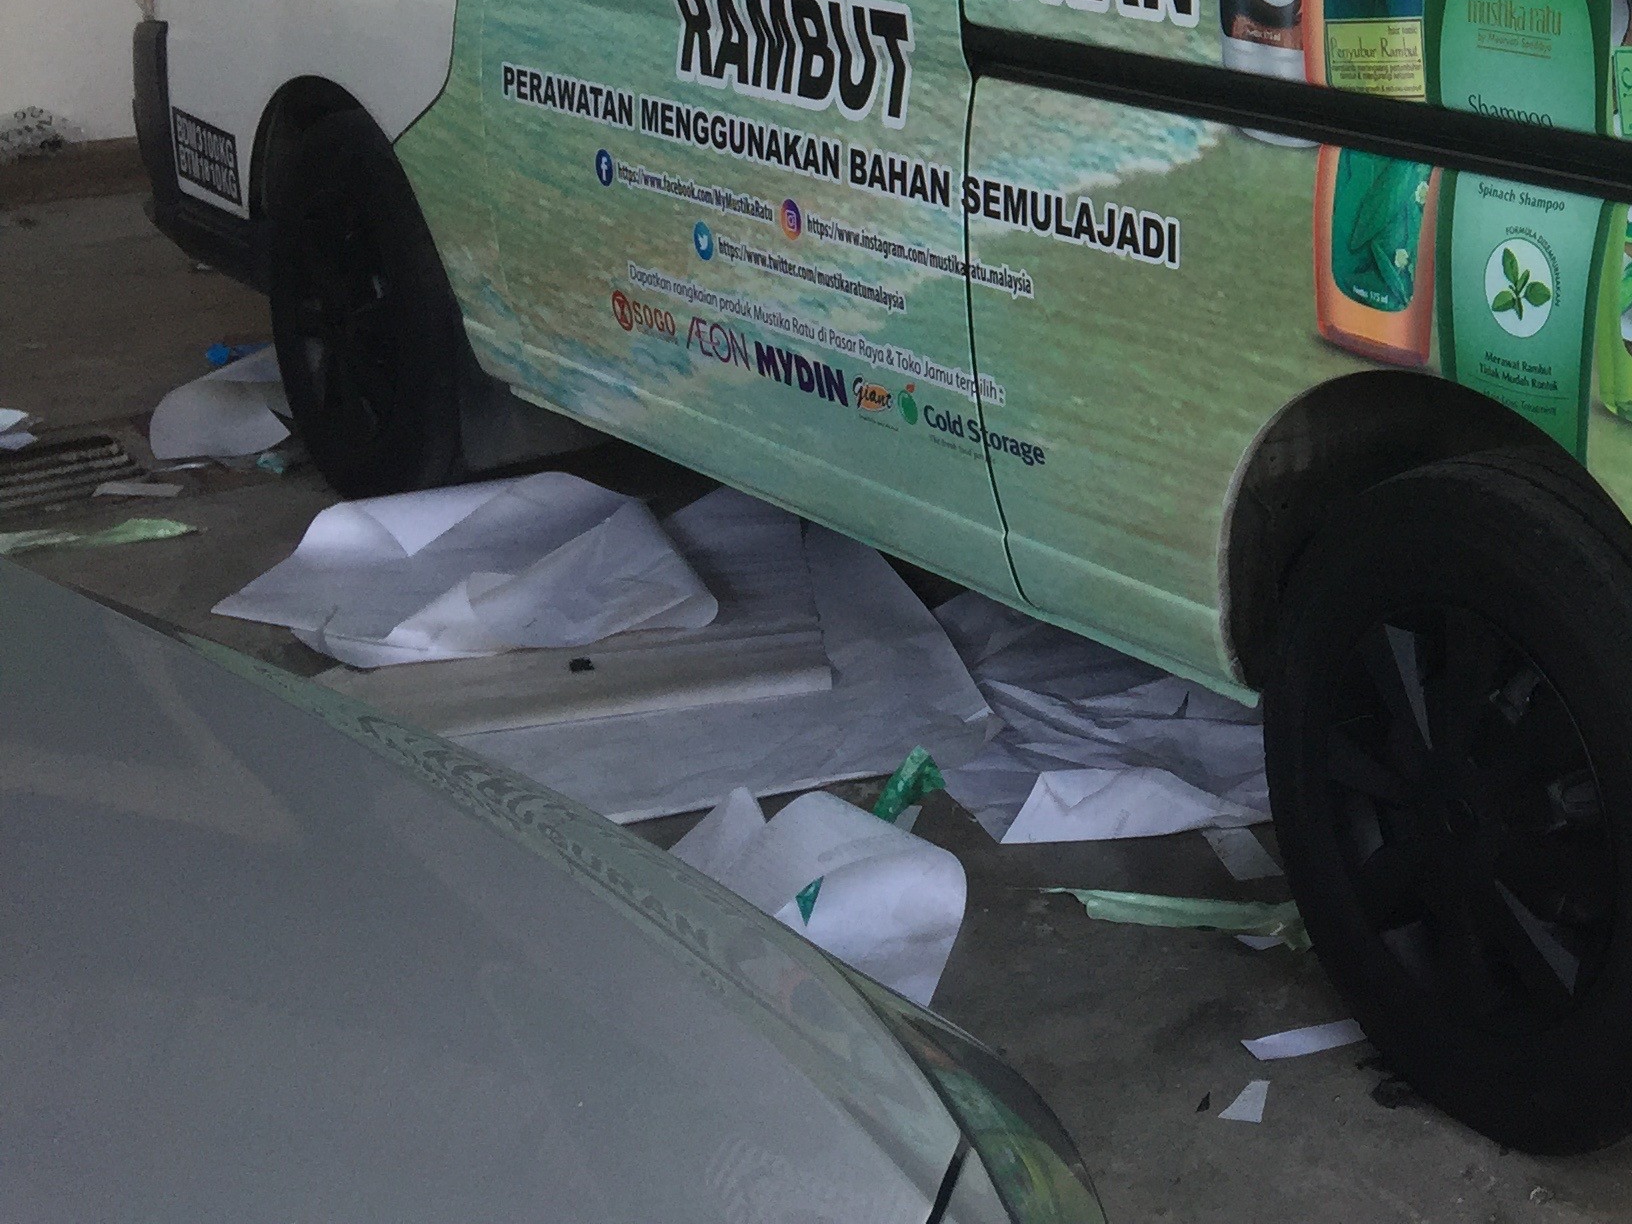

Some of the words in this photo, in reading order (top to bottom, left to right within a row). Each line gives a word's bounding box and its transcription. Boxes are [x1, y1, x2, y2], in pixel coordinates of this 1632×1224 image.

[1530, 5, 1562, 36] ratu
[503, 65, 633, 128] PERAWATAN
[641, 98, 840, 180] MENGGUNAKAN
[850, 147, 951, 208] BAHAN
[962, 178, 1178, 261] SEMULAJADI
[1478, 181, 1516, 204] Spinach
[1518, 191, 1565, 214] Shampoo
[632, 300, 676, 337] SOGO
[720, 297, 752, 320] produk
[753, 304, 791, 332] Mustika
[793, 318, 815, 341] Ratu
[817, 327, 827, 344] di
[829, 329, 857, 353] Pasar
[859, 338, 885, 364] Raya
[886, 347, 895, 366] &
[895, 350, 922, 376] Toko
[923, 362, 954, 386] Jamu
[755, 340, 849, 408] MYDIN
[924, 404, 964, 439] Cold
